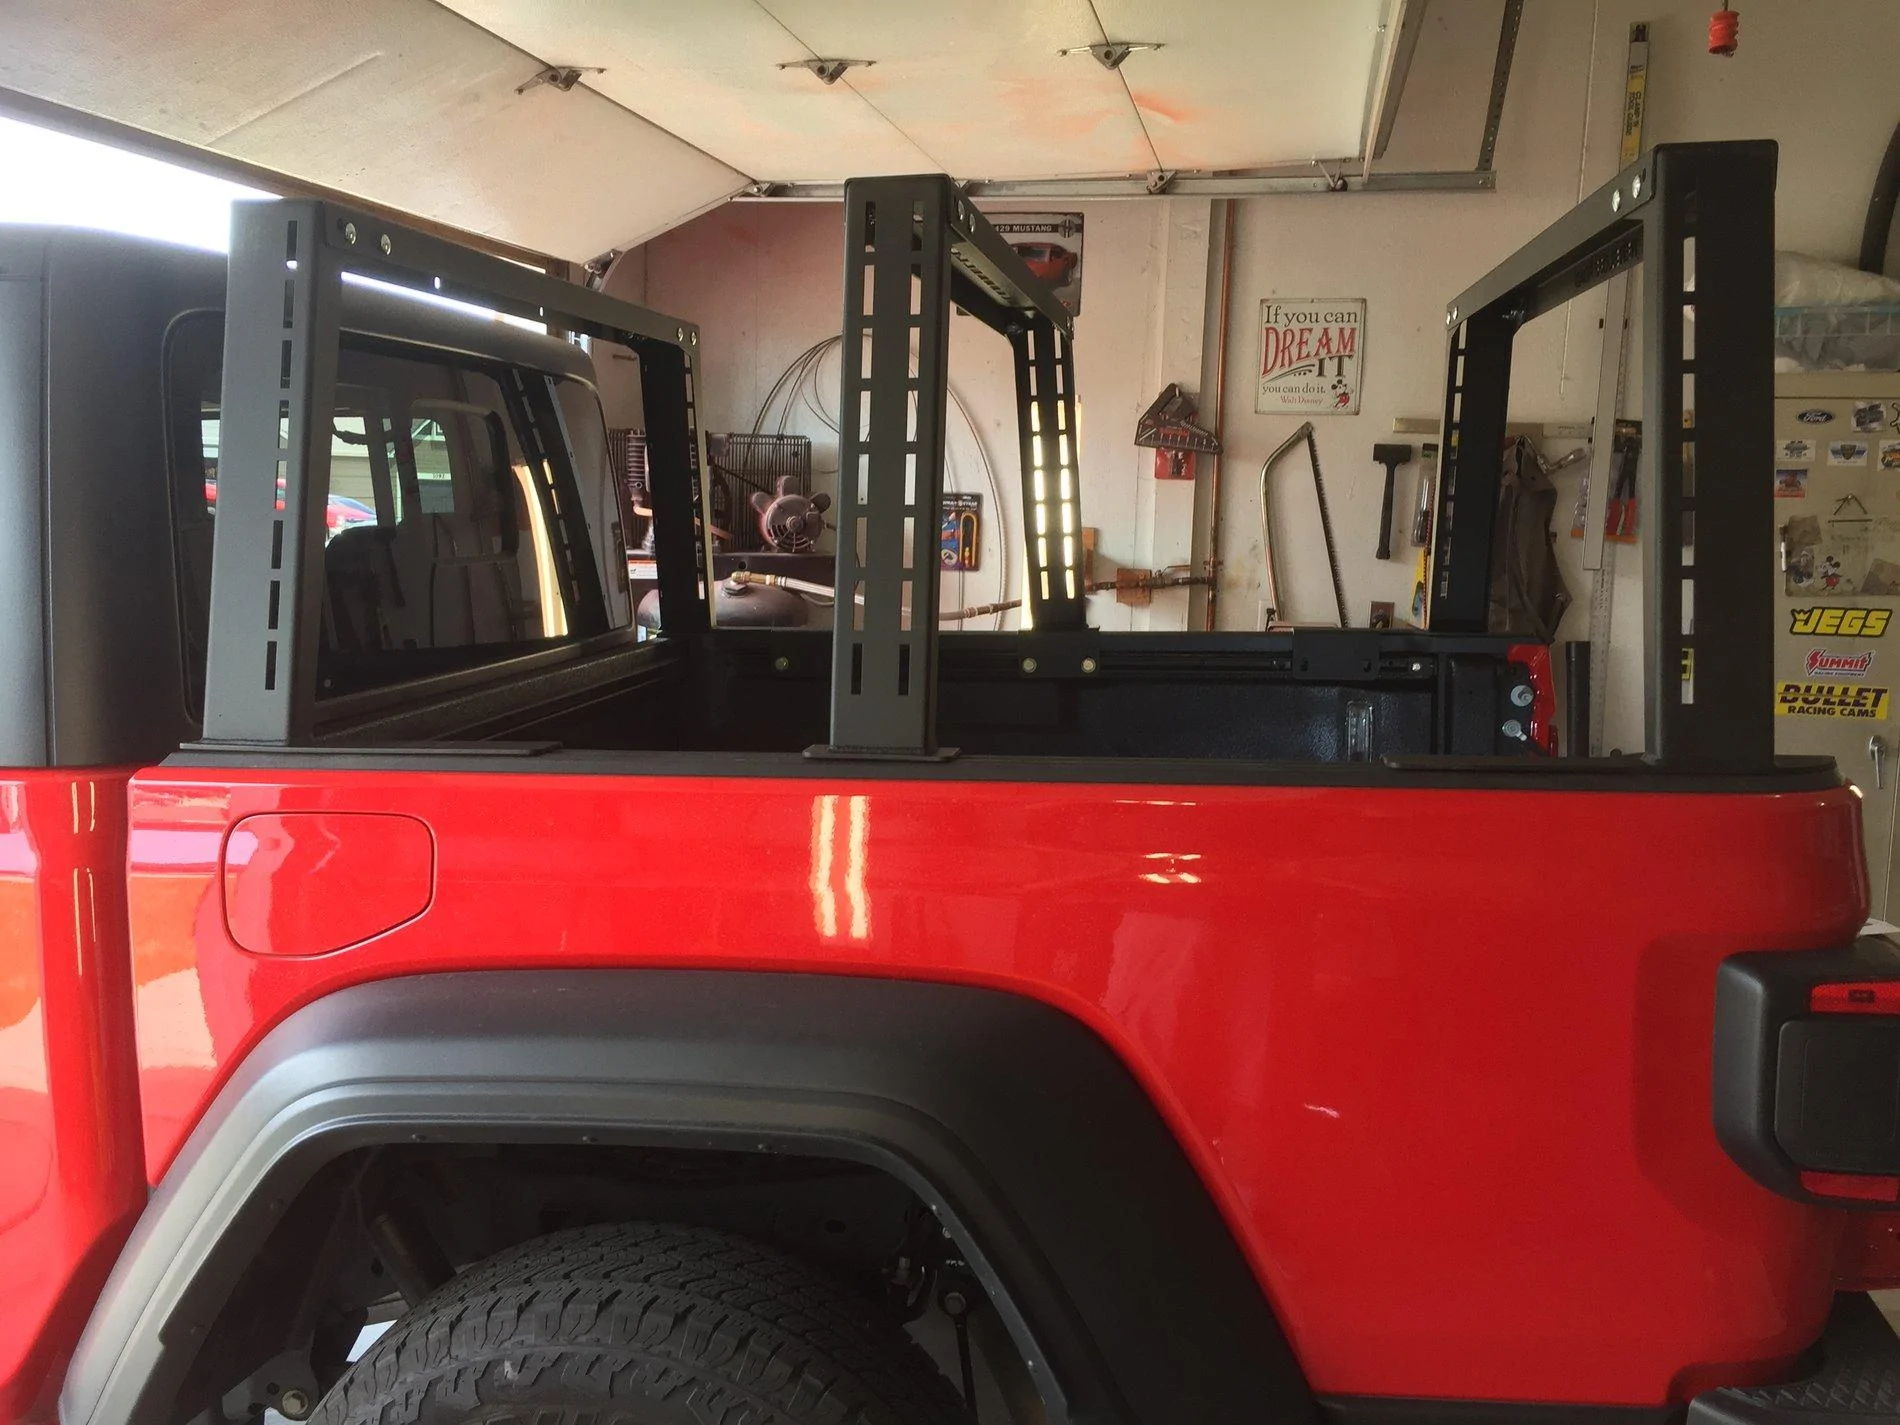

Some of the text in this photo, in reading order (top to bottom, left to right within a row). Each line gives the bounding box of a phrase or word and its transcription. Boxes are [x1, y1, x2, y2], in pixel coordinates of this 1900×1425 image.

[1012, 225, 1053, 233] MUSTANG
[1265, 305, 1358, 327] If you can
[1262, 327, 1356, 378] DREAM
[1316, 355, 1354, 378] IT
[1262, 385, 1281, 395] you
[1282, 385, 1301, 394] can
[1302, 383, 1316, 394] do
[1280, 396, 1297, 404] Walt
[1790, 607, 1893, 638] JEGS
[1779, 684, 1888, 708] BULLET
[1787, 705, 1877, 718] RACING CAMS
